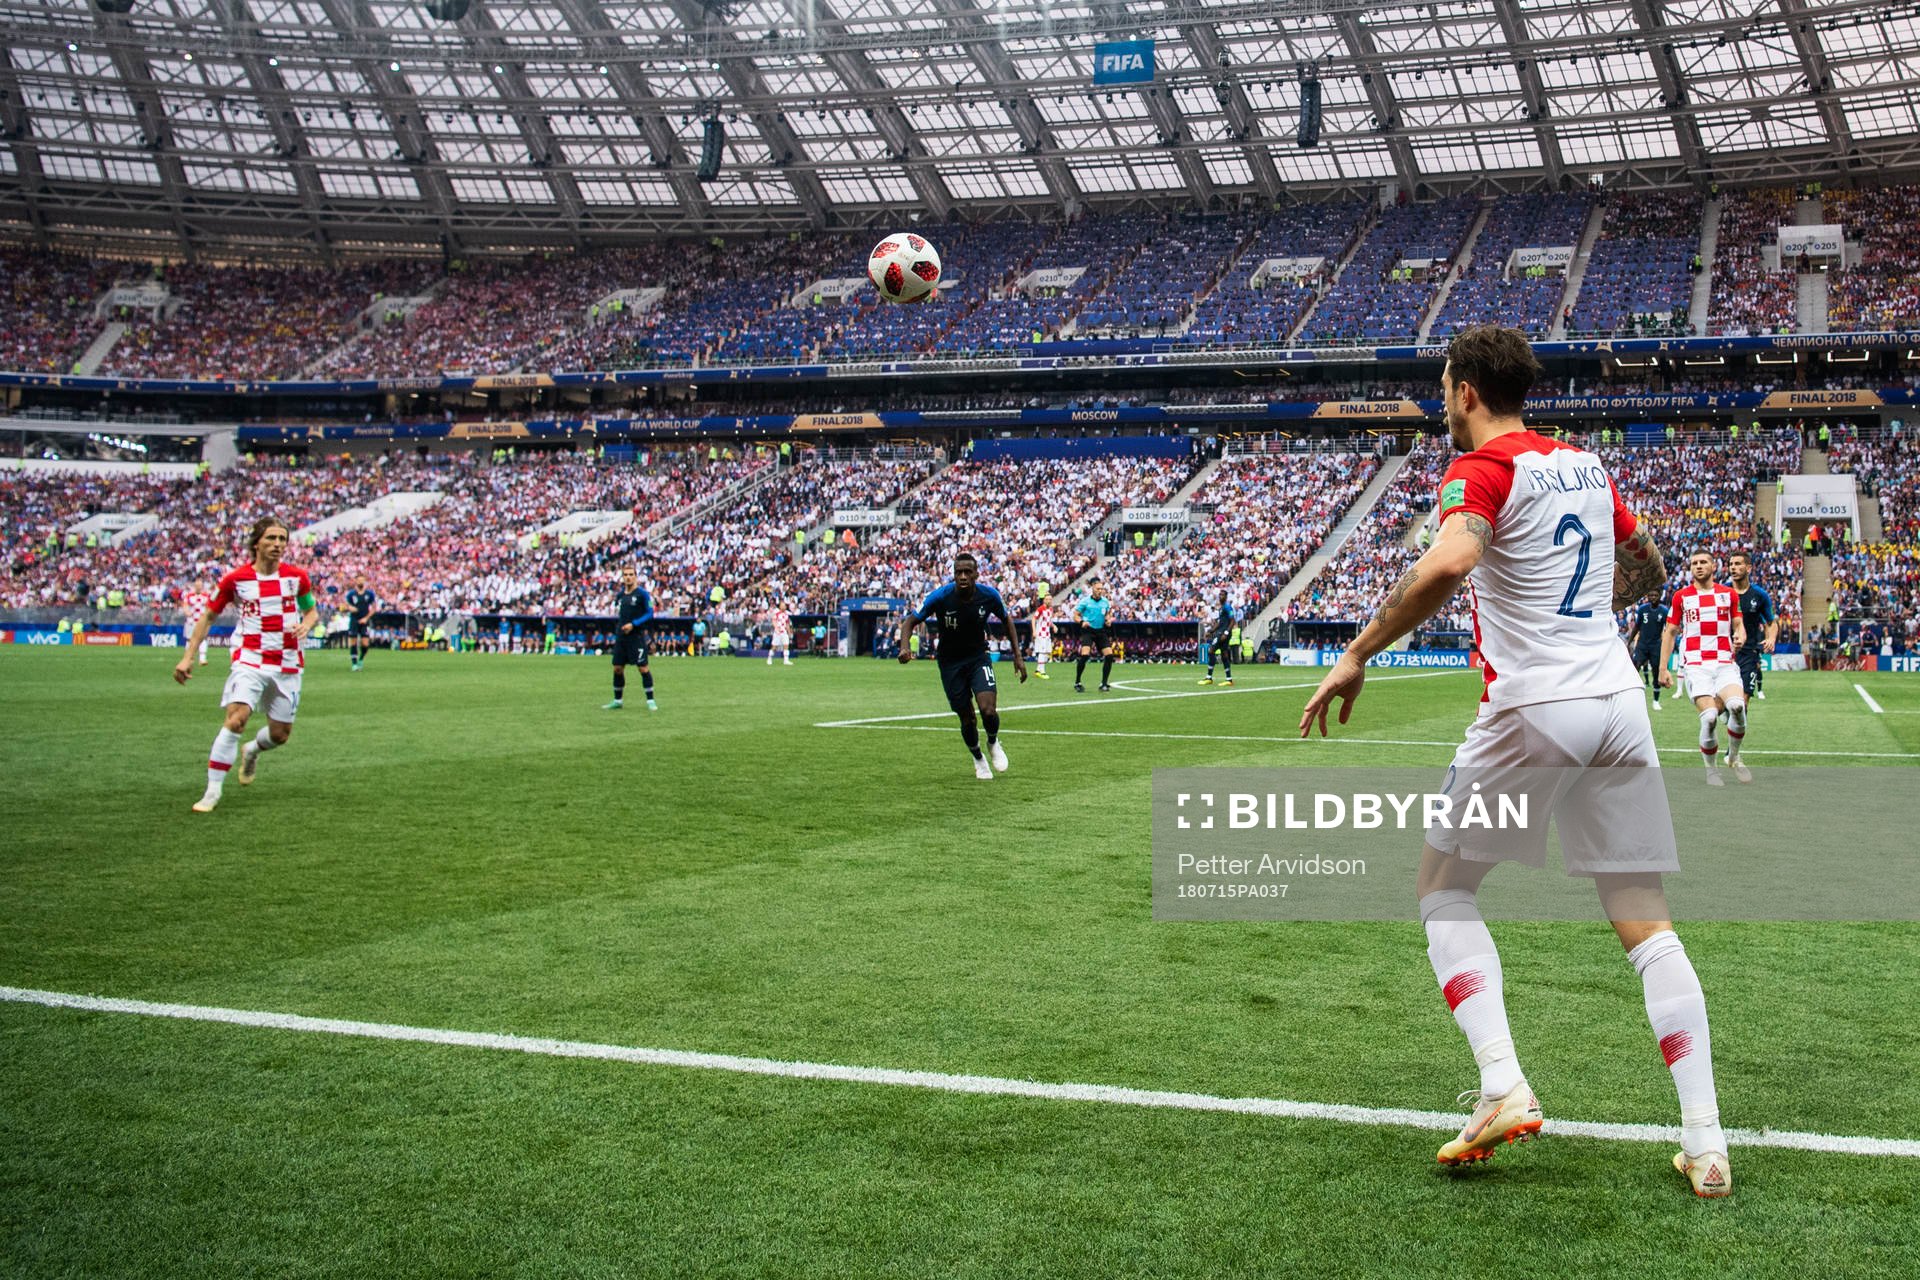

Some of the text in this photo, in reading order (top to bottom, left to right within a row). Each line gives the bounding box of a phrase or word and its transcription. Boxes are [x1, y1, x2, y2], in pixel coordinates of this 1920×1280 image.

[1103, 54, 1144, 72] FIFA
[1821, 242, 1837, 250] 205
[1772, 335, 1848, 348] ЧЕМПИОНАТ
[1852, 334, 1886, 345] МИРА
[1890, 334, 1907, 343] ПО
[1416, 348, 1449, 358] MOSC
[493, 377, 516, 385] FINAL
[1555, 399, 1588, 409] МИРА
[1591, 398, 1608, 408] ПО
[1610, 396, 1669, 408] ФУТБОЛУ
[1671, 396, 1695, 406] FIFA
[1791, 393, 1857, 403] FINAL 2018
[1340, 403, 1400, 414] FINAL 2018
[813, 415, 863, 425] FINAL 2018
[1072, 410, 1118, 420] MOSCOW
[468, 425, 491, 433] FINAL
[630, 420, 700, 430] FIFA WORLD CUP
[1796, 506, 1813, 514] 104
[1553, 513, 1593, 618] 2
[944, 616, 958, 630] 14
[149, 632, 178, 647] VISA
[638, 648, 644, 659] 7
[1393, 654, 1420, 666] 万达
[1421, 655, 1467, 666] WANDA
[982, 665, 995, 681] 14
